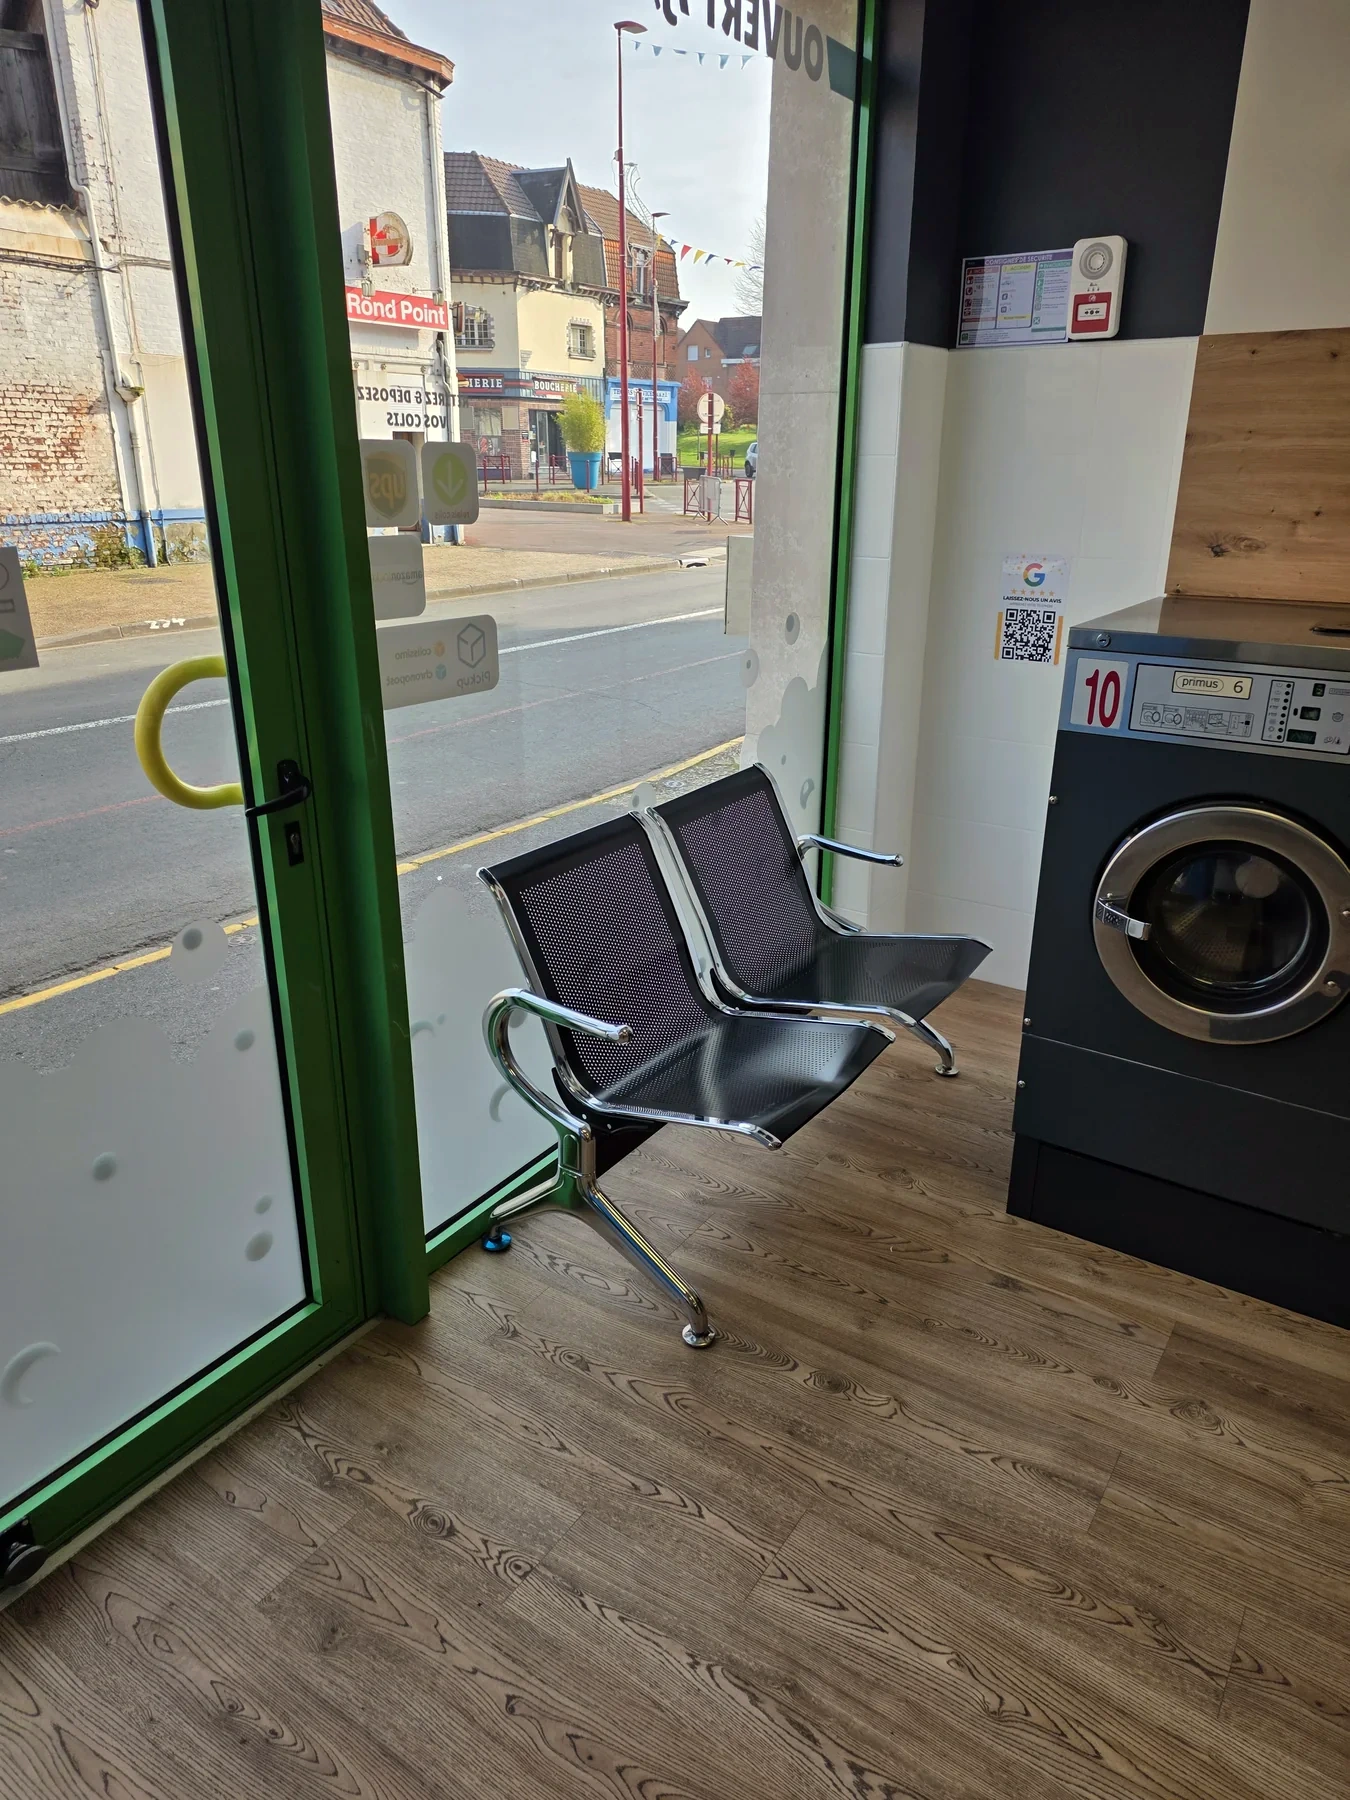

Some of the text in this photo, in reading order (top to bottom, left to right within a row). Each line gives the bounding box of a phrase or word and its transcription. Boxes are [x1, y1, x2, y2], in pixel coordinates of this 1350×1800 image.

[346, 293, 446, 325] Rond Point
[534, 380, 577, 393] BOUCHERIE
[1181, 676, 1244, 694] primus 6
[1085, 668, 1121, 728] 10
